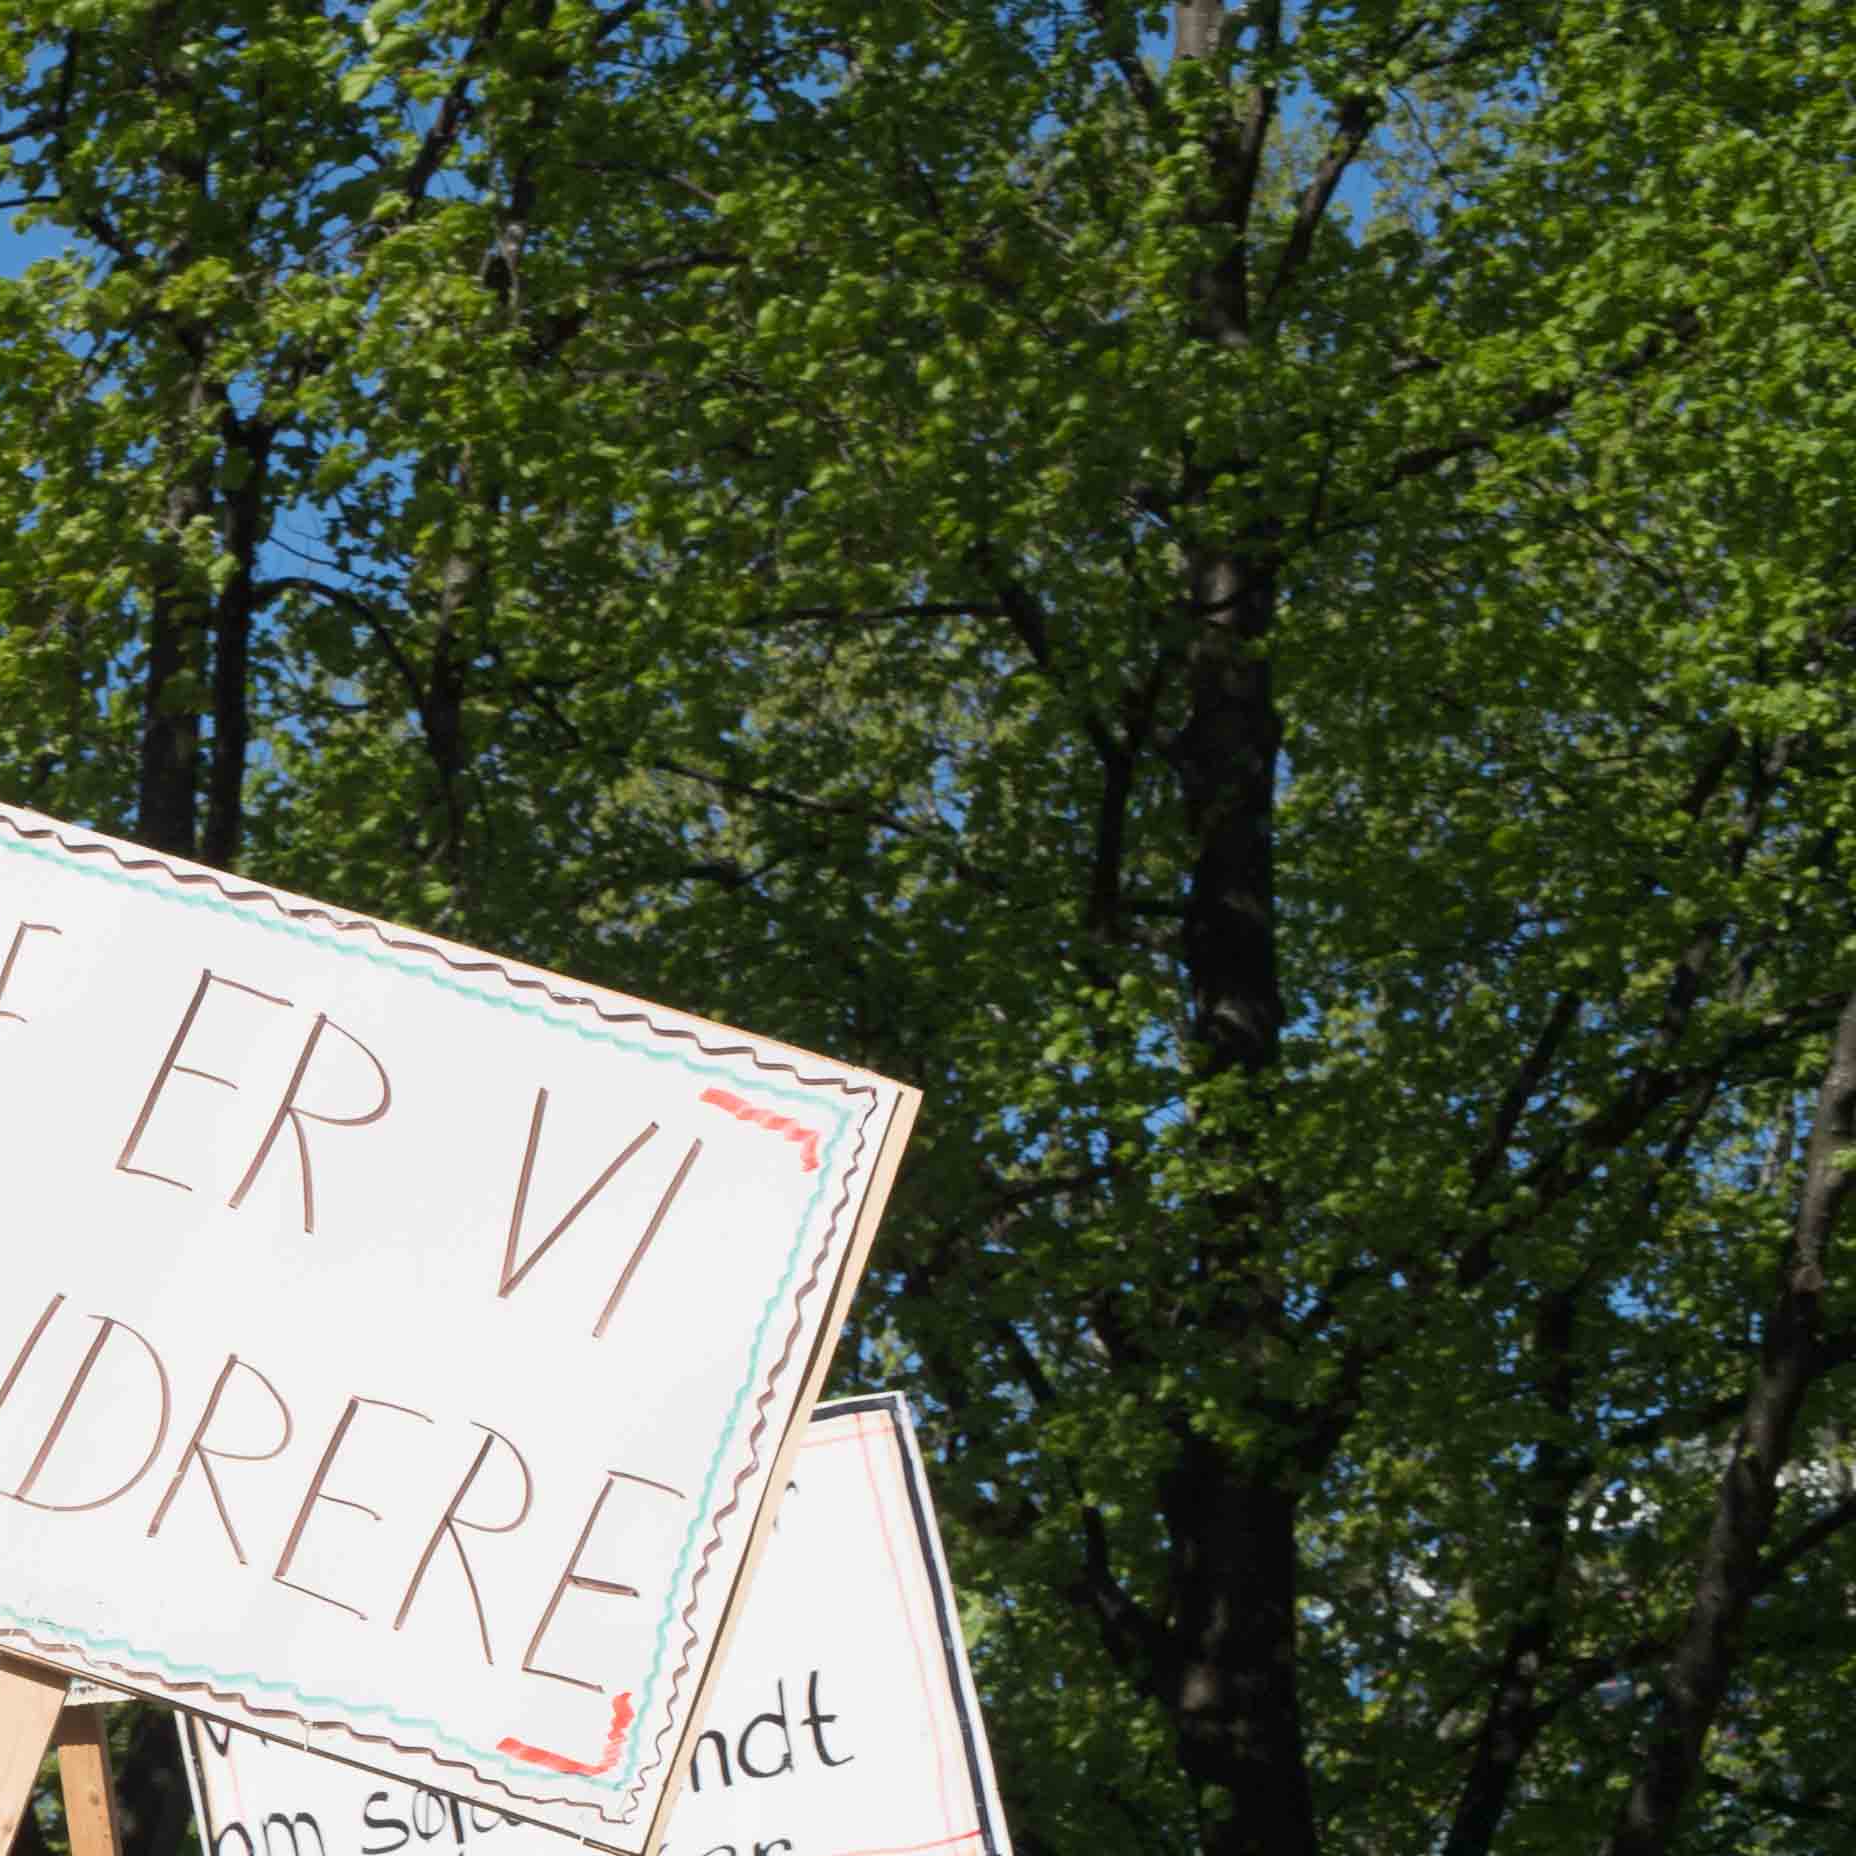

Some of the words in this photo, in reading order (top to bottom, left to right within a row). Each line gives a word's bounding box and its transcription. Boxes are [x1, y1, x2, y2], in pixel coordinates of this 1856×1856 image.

[115, 969, 392, 1234] ER
[497, 1086, 704, 1340] VI
[690, 1670, 855, 1794] ndt
